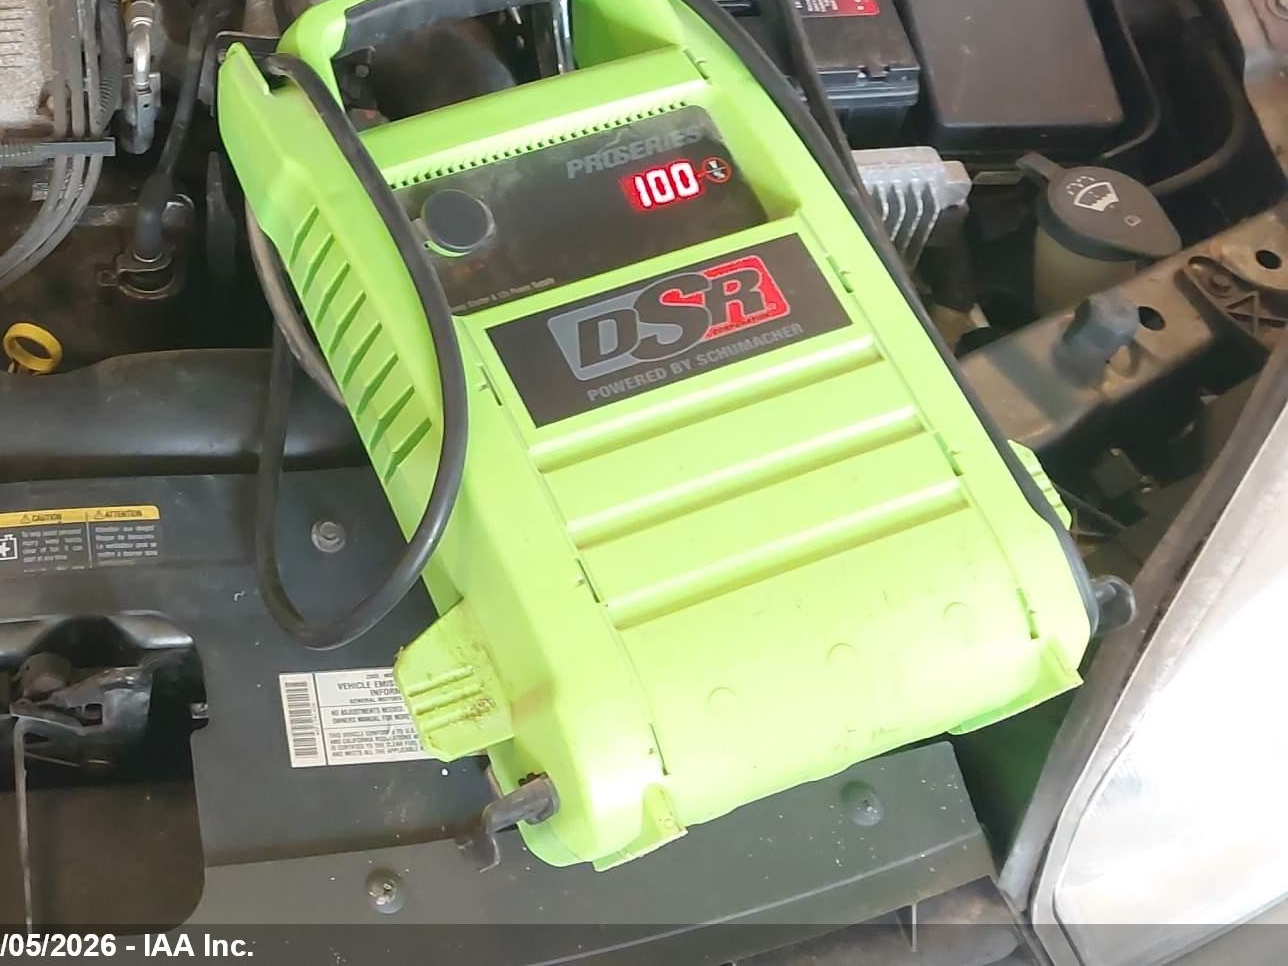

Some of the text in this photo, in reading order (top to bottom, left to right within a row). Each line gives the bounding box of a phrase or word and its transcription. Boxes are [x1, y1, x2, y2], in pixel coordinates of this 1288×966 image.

[566, 127, 702, 179] PROSERIES
[633, 161, 700, 208] 100
[568, 260, 784, 374] DSR
[587, 367, 668, 402] POWERED
[669, 358, 693, 375] BY
[695, 322, 805, 366] SCHUMACHER
[31, 513, 62, 522] CAUTION
[105, 509, 143, 518] ATTENTION
[337, 681, 371, 690] VEHICLE
